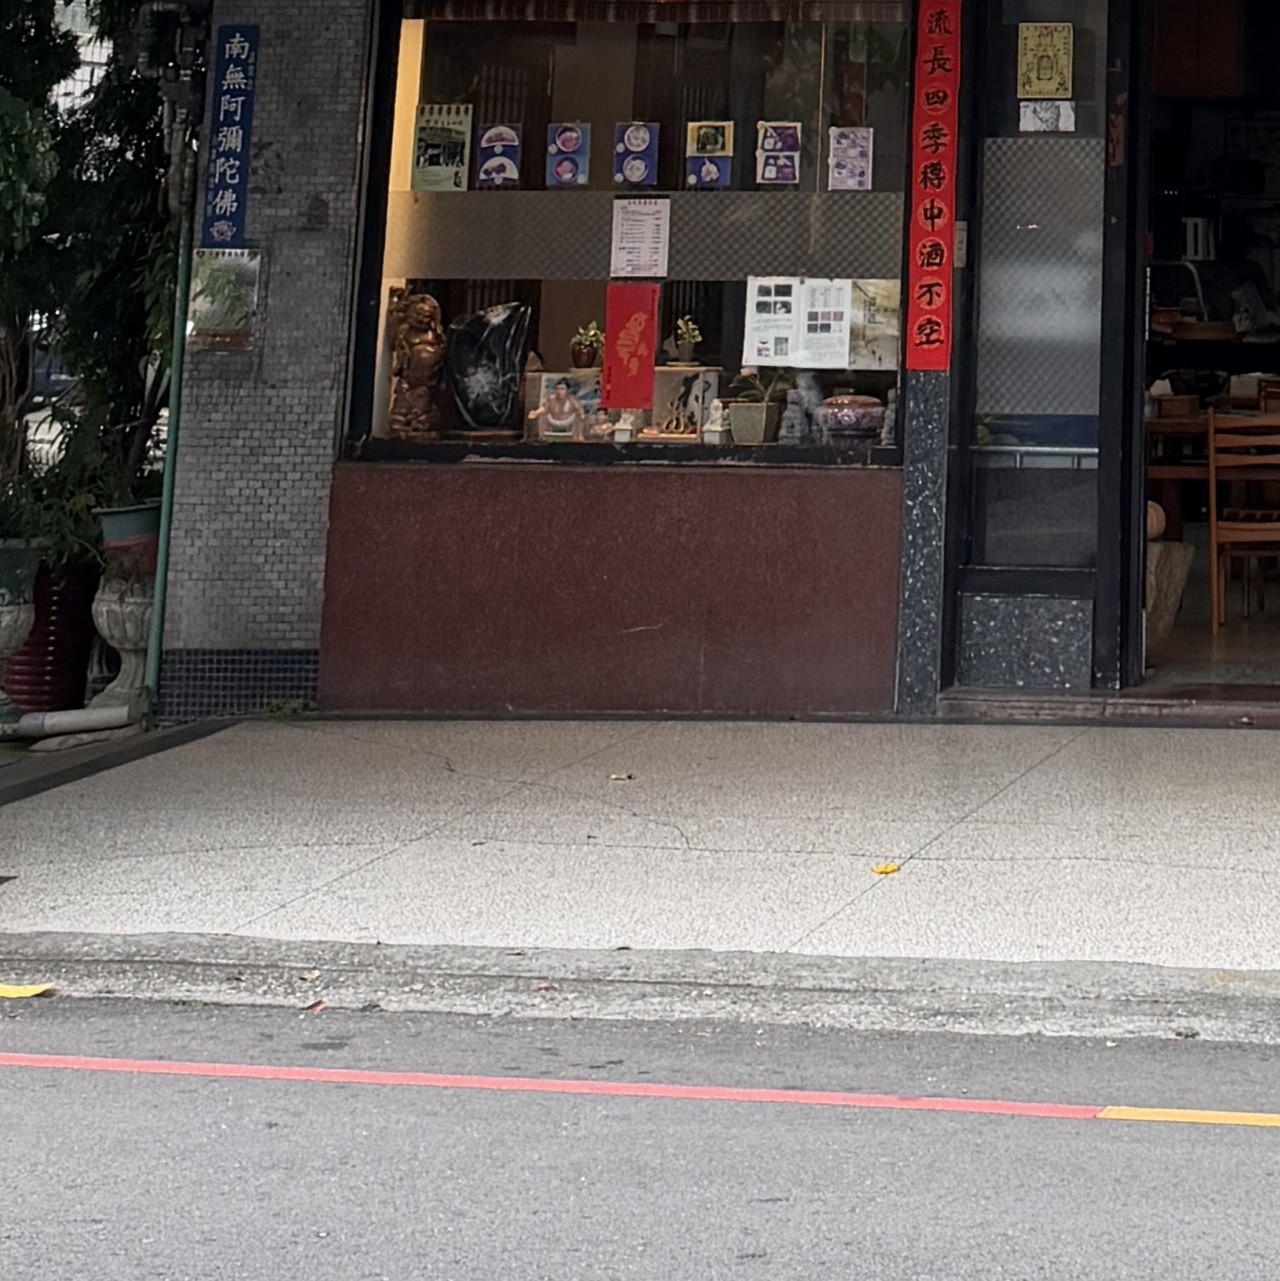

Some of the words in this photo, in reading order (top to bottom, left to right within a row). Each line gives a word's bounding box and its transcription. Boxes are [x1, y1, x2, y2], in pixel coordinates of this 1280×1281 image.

[212, 33, 250, 217] 南無阿彌陀佛
